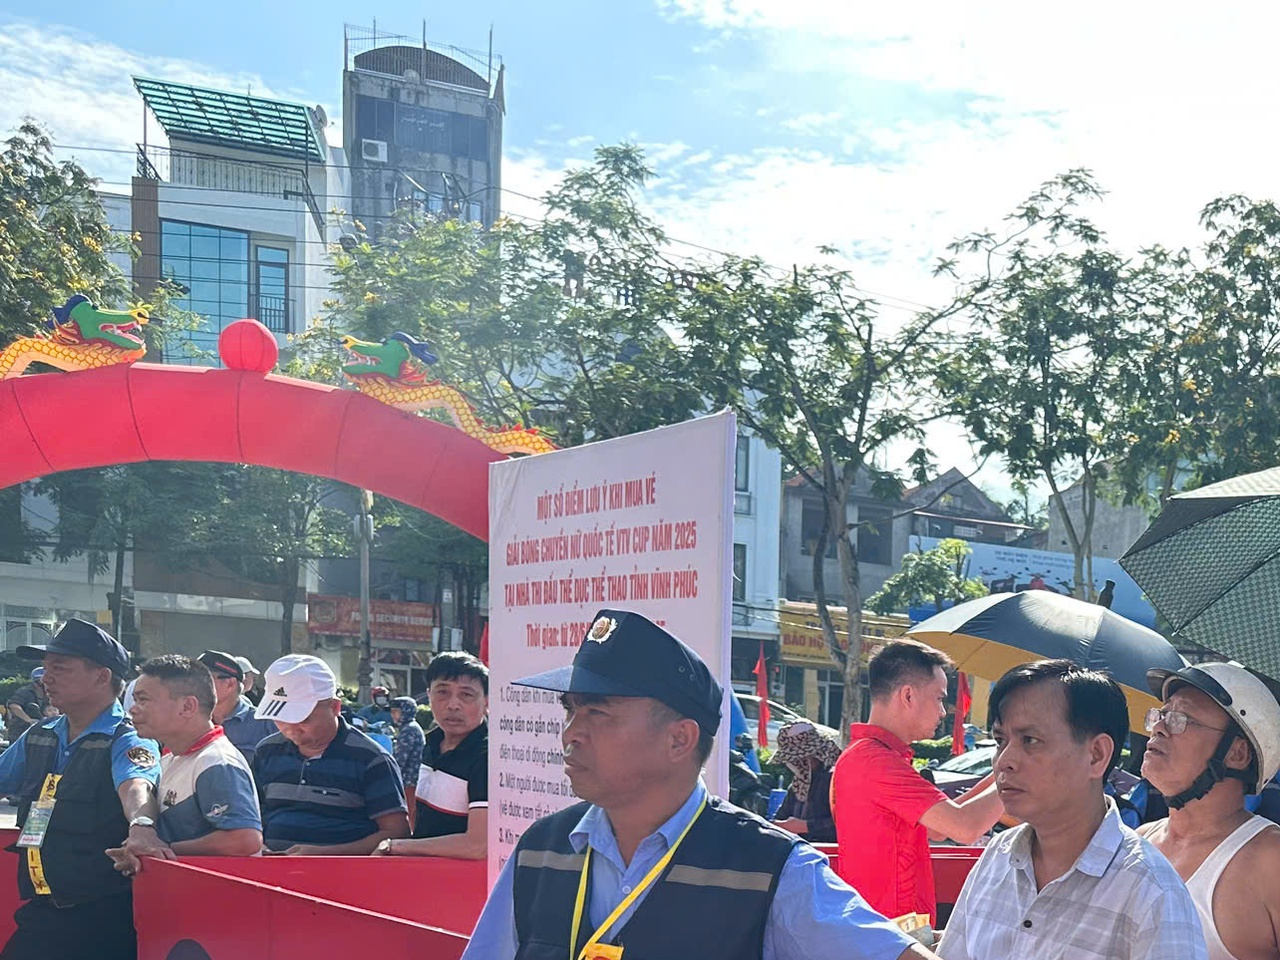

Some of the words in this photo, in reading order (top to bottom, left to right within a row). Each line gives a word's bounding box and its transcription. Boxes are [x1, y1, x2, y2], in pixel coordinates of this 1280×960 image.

[554, 483, 564, 518] SỐ
[601, 479, 608, 511] Ý
[609, 483, 623, 511] KHI
[625, 480, 643, 508] MUA
[645, 471, 656, 505] VÉ
[583, 522, 603, 562] QUỐC
[605, 521, 616, 557] TẾ
[617, 526, 631, 555] VTV
[632, 525, 650, 554] CUP
[651, 518, 672, 551] NĂM
[675, 521, 697, 550] 2025
[531, 581, 542, 606] THI
[574, 577, 589, 608] DỤC
[607, 574, 628, 602] THAO
[651, 567, 671, 599] VĨNH
[673, 565, 698, 599] PHÚC
